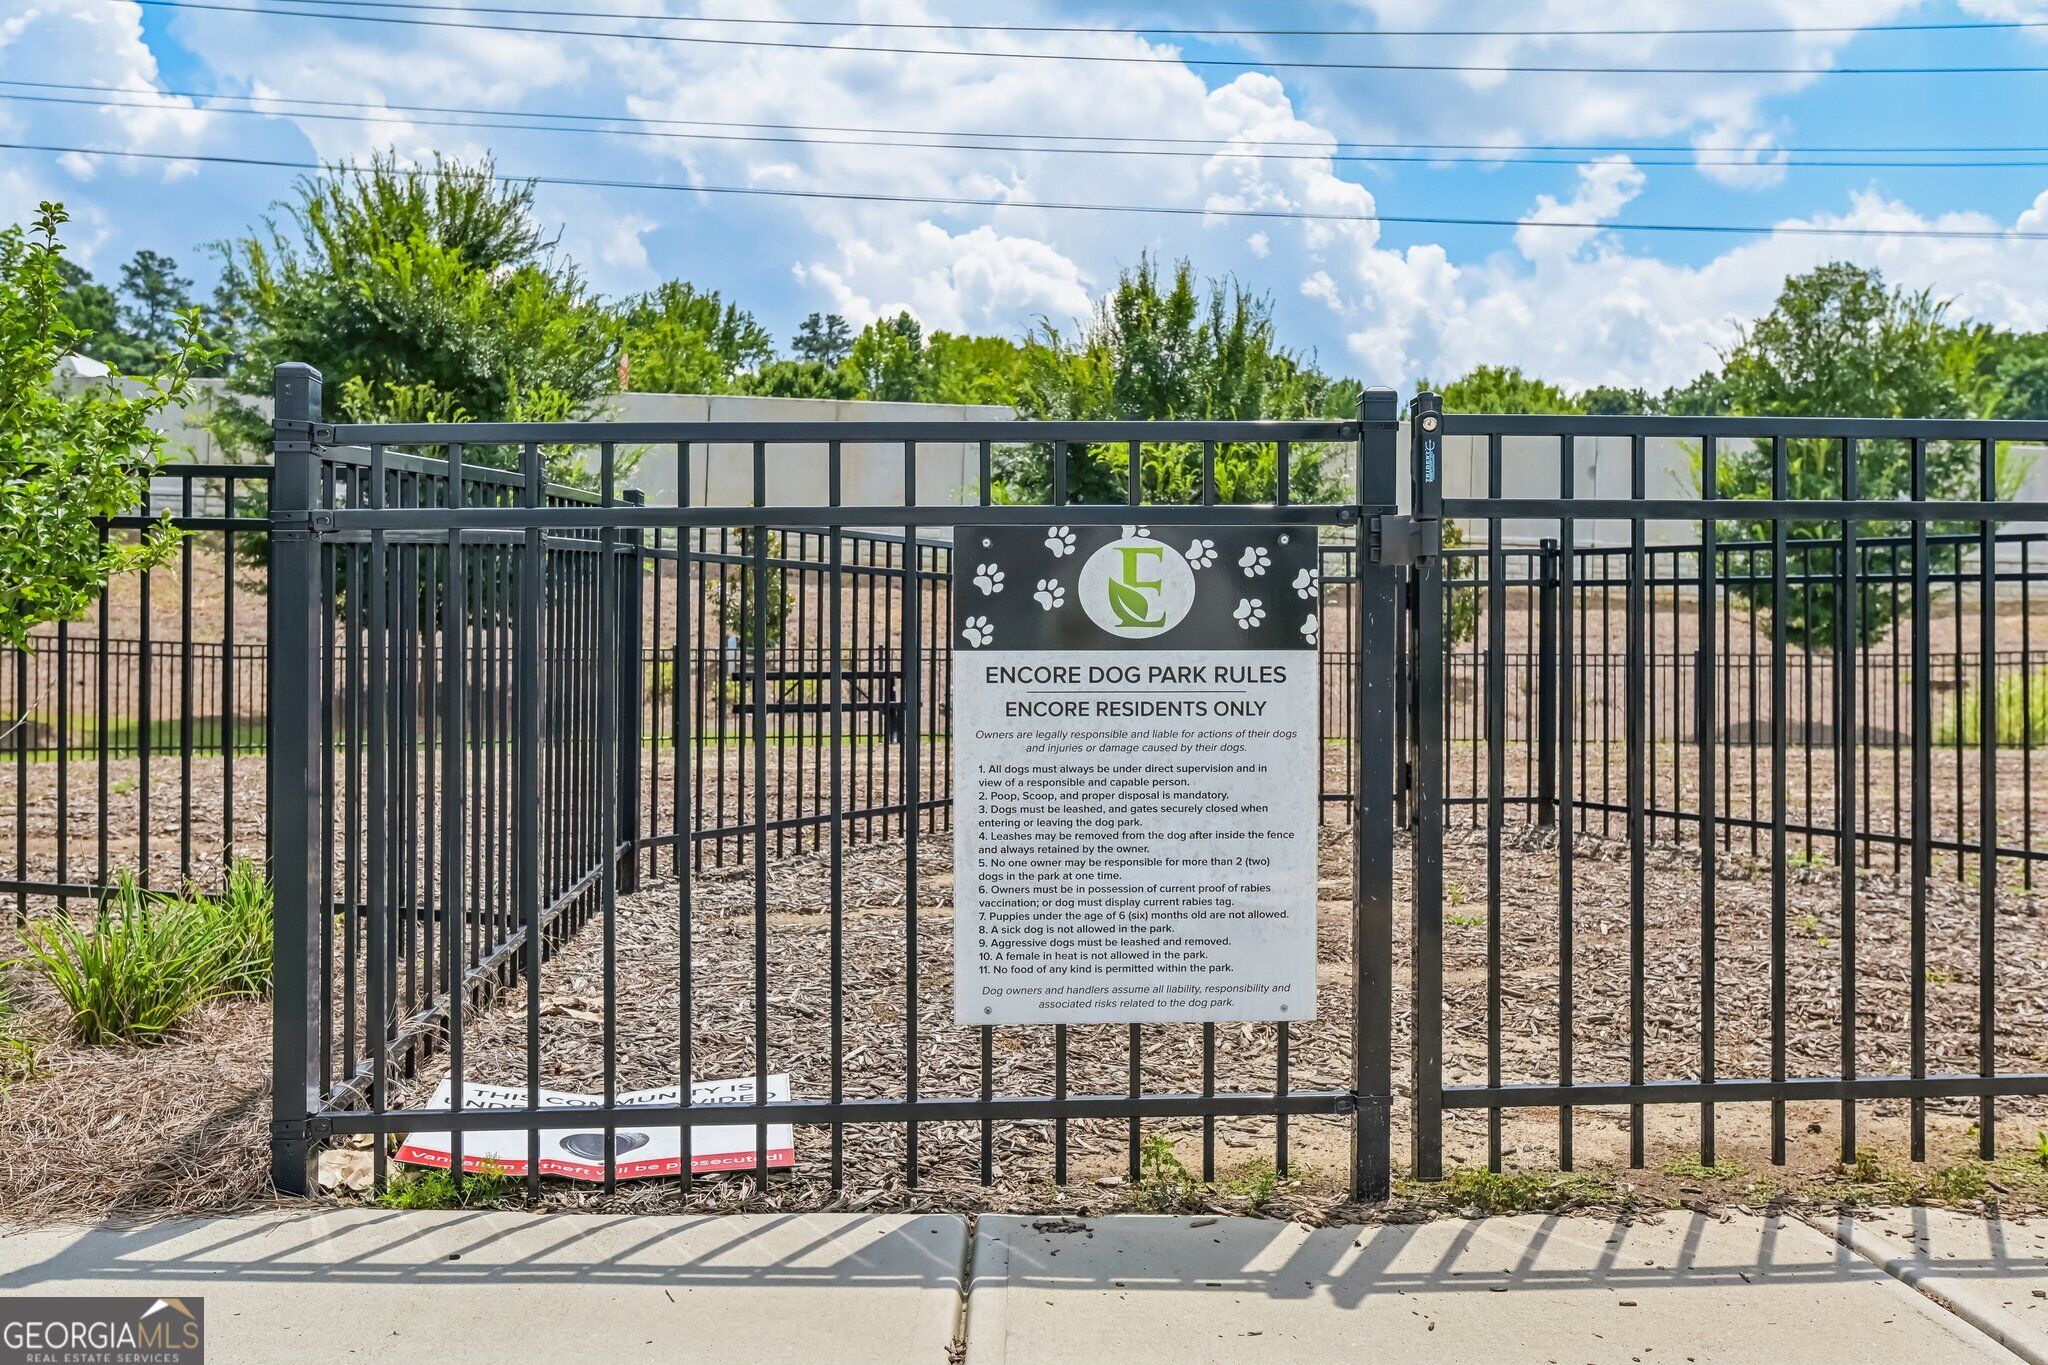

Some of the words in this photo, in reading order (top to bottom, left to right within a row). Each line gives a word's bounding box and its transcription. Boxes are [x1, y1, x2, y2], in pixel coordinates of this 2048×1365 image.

[985, 665, 1081, 684] ENCORE
[1088, 665, 1141, 684] DOG
[1148, 665, 1207, 684] PARK
[1214, 665, 1287, 683] RULES
[1005, 701, 1090, 717] ENCORE
[1096, 700, 1208, 717] RESIDENTS
[1213, 700, 1267, 717] ONLY
[975, 729, 1014, 739] Owners
[1016, 731, 1033, 739] are
[1035, 729, 1068, 741] legally
[1070, 729, 1128, 741] responsible
[1130, 729, 1150, 739] and
[1151, 729, 1179, 739] liable
[1181, 729, 1195, 739] for
[1197, 729, 1233, 739] actions
[1234, 728, 1247, 738] of
[1247, 729, 1270, 738] their
[1272, 729, 1297, 740] dogs
[1025, 743, 1046, 753] and
[1047, 743, 1083, 755] injuries
[1085, 744, 1097, 753] or
[1098, 742, 1140, 754] damage
[1141, 743, 1178, 752] caused
[1180, 742, 1193, 754] by
[1195, 742, 1218, 752] their
[1219, 742, 1247, 754] dogs.
[978, 764, 986, 774] 1.
[988, 764, 1002, 774] All
[1004, 764, 1030, 776] dogs
[1032, 764, 1057, 774] must
[1059, 764, 1095, 775] always
[1096, 763, 1110, 773] be
[1112, 763, 1143, 773] under
[1144, 763, 1174, 773] direct
[1176, 763, 1234, 775] supervision
[1236, 763, 1255, 773] and
[1258, 763, 1267, 772] in
[978, 778, 1003, 787] view
[1004, 777, 1016, 787] of
[1017, 779, 1024, 787] a
[1026, 777, 1086, 789] responsible
[1087, 777, 1107, 787] and
[1109, 777, 1150, 788] capable
[1151, 778, 1190, 788] person.
[978, 791, 988, 801] 2.
[990, 791, 1020, 802] Poop,
[1022, 791, 1057, 802] Scoop,
[1059, 790, 1079, 800] and
[1081, 792, 1116, 802] proper
[1117, 790, 1160, 802] disposal
[1162, 790, 1171, 800] is
[1173, 790, 1229, 801] mandatory.
[978, 804, 988, 814] 3.
[990, 804, 1017, 816] Dogs
[1019, 805, 1045, 814] must
[1047, 804, 1061, 814] be
[1063, 804, 1106, 814] leashed,
[1107, 804, 1127, 814] and
[1129, 804, 1158, 815] gates
[1160, 803, 1203, 815] securely
[1205, 803, 1238, 813] closed
[1240, 803, 1268, 813] when
[978, 818, 1021, 830] entering
[1022, 819, 1034, 827] or
[1036, 817, 1073, 829] leaving
[1075, 817, 1093, 827] the
[1094, 817, 1115, 829] dog
[1117, 817, 1143, 829] park.
[978, 831, 988, 841] 4.
[990, 831, 1032, 841] Leashes
[1034, 833, 1057, 843] may
[1058, 831, 1072, 840] be
[1074, 830, 1119, 840] removed
[1121, 830, 1145, 840] from
[1147, 830, 1164, 840] the
[1166, 830, 1187, 842] dog
[1188, 830, 1213, 840] after
[1215, 830, 1246, 839] inside
[1247, 830, 1264, 839] the
[1266, 830, 1295, 839] fence
[978, 844, 998, 854] and
[1000, 844, 1035, 856] always
[1037, 844, 1080, 854] retained
[1082, 844, 1095, 856] by
[1096, 844, 1114, 854] the
[1115, 845, 1150, 853] owner.
[978, 871, 1004, 883] dogs
[1006, 871, 1015, 881] in
[1017, 871, 1035, 881] the
[1037, 871, 1060, 883] park
[1062, 871, 1073, 880] at
[1074, 872, 1095, 880] one
[1096, 871, 1122, 880] time.
[978, 898, 1039, 908] vaccination;
[1041, 899, 1053, 907] or
[1054, 897, 1075, 909] dog
[1077, 898, 1103, 907] must
[1104, 897, 1141, 909] display
[1143, 897, 1180, 907] current
[1181, 896, 1213, 906] rabies
[1214, 897, 1234, 908] tag.
[978, 925, 988, 934] 8.
[990, 925, 999, 934] A
[1000, 924, 1021, 934] sick
[1023, 924, 1044, 936] dog
[1046, 924, 1055, 934] is
[1057, 924, 1074, 934] not
[1076, 924, 1116, 934] allowed
[1118, 924, 1128, 933] in
[1129, 923, 1147, 933] the
[1149, 923, 1175, 935] park.
[978, 938, 988, 948] 9.
[990, 938, 1047, 950] Aggressive
[1049, 937, 1075, 949] dogs
[1077, 936, 1103, 947] must
[1104, 937, 1118, 947] be
[1120, 937, 1161, 947] leashed
[1162, 936, 1182, 946] and
[1184, 936, 1231, 946] removed.
[982, 986, 1003, 997] Dog
[1005, 987, 1042, 995] owners
[1044, 985, 1064, 995] and
[1066, 985, 1109, 995] handlers
[1111, 986, 1150, 994] assume
[1152, 984, 1164, 994] all
[1166, 984, 1202, 996] liability,
[1204, 983, 1270, 995] responsibility
[1271, 983, 1291, 992] and
[1038, 999, 1092, 1009] associated
[1094, 998, 1117, 1008] risks
[1119, 998, 1155, 1008] related
[1157, 999, 1167, 1007] to
[1169, 998, 1186, 1007] the
[1187, 997, 1208, 1009] dog
[1209, 997, 1235, 1009] park.
[546, 1086, 720, 1107] COMUNTY
[731, 1083, 754, 1092] IS
[412, 1150, 515, 1170] Vanalim
[542, 1163, 591, 1175] theft
[596, 1167, 628, 1176] wll
[635, 1163, 659, 1172] be
[666, 1153, 783, 1170] posecutd!
